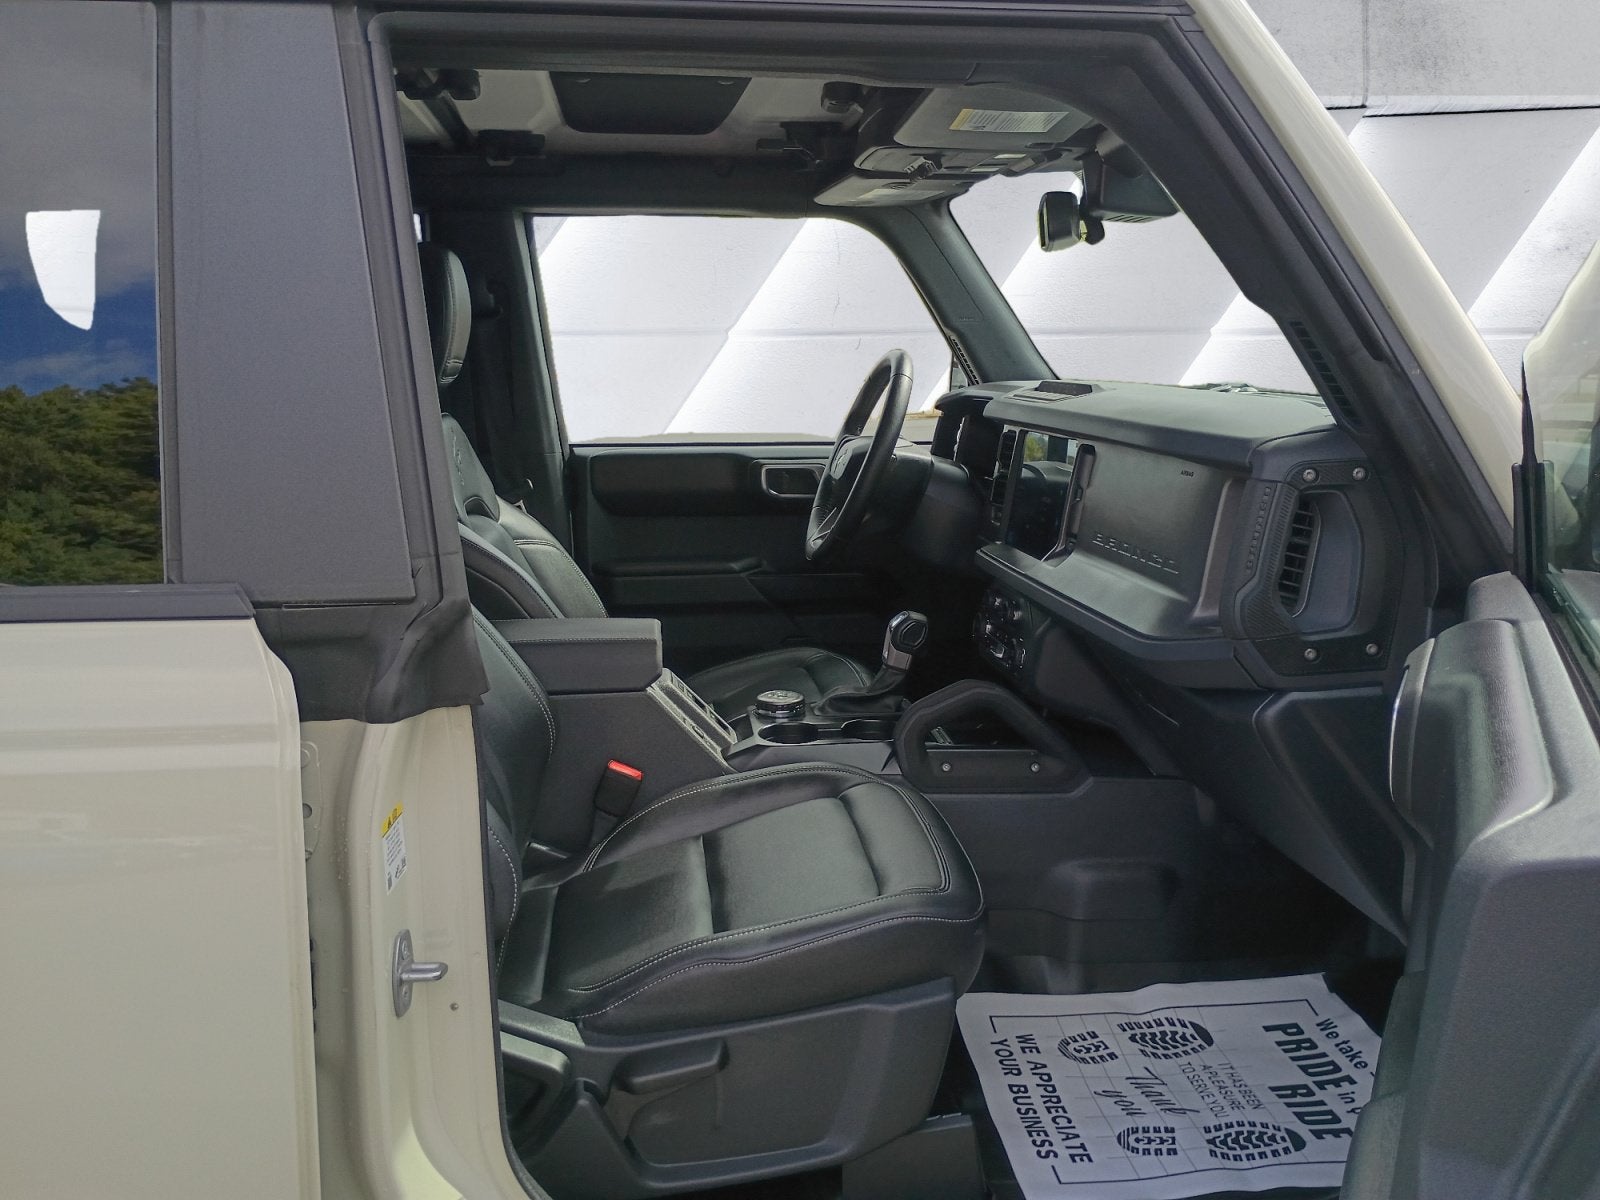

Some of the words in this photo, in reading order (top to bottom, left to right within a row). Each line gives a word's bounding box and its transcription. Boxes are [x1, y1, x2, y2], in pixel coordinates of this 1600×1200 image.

[1015, 1033, 1042, 1055] WE
[1316, 1018, 1339, 1039] We
[1334, 1040, 1368, 1069] take
[1179, 1061, 1196, 1074] TO
[1218, 1062, 1235, 1071] IT
[1262, 1022, 1358, 1091] PRIDE
[1337, 1091, 1356, 1104] in
[1125, 1066, 1201, 1116] Thank
[1187, 1073, 1216, 1101] SERVE
[1204, 1070, 1246, 1111] PLEASURE
[1224, 1072, 1249, 1089] HAS
[990, 1038, 1023, 1078] YOUR
[1007, 1083, 1059, 1160] BUSINESS
[1026, 1060, 1094, 1164] APPRECIATE
[1093, 1089, 1147, 1117] you
[1207, 1099, 1230, 1118] YOU
[1238, 1089, 1265, 1110] BEEN
[1267, 1083, 1354, 1140] RIDE
